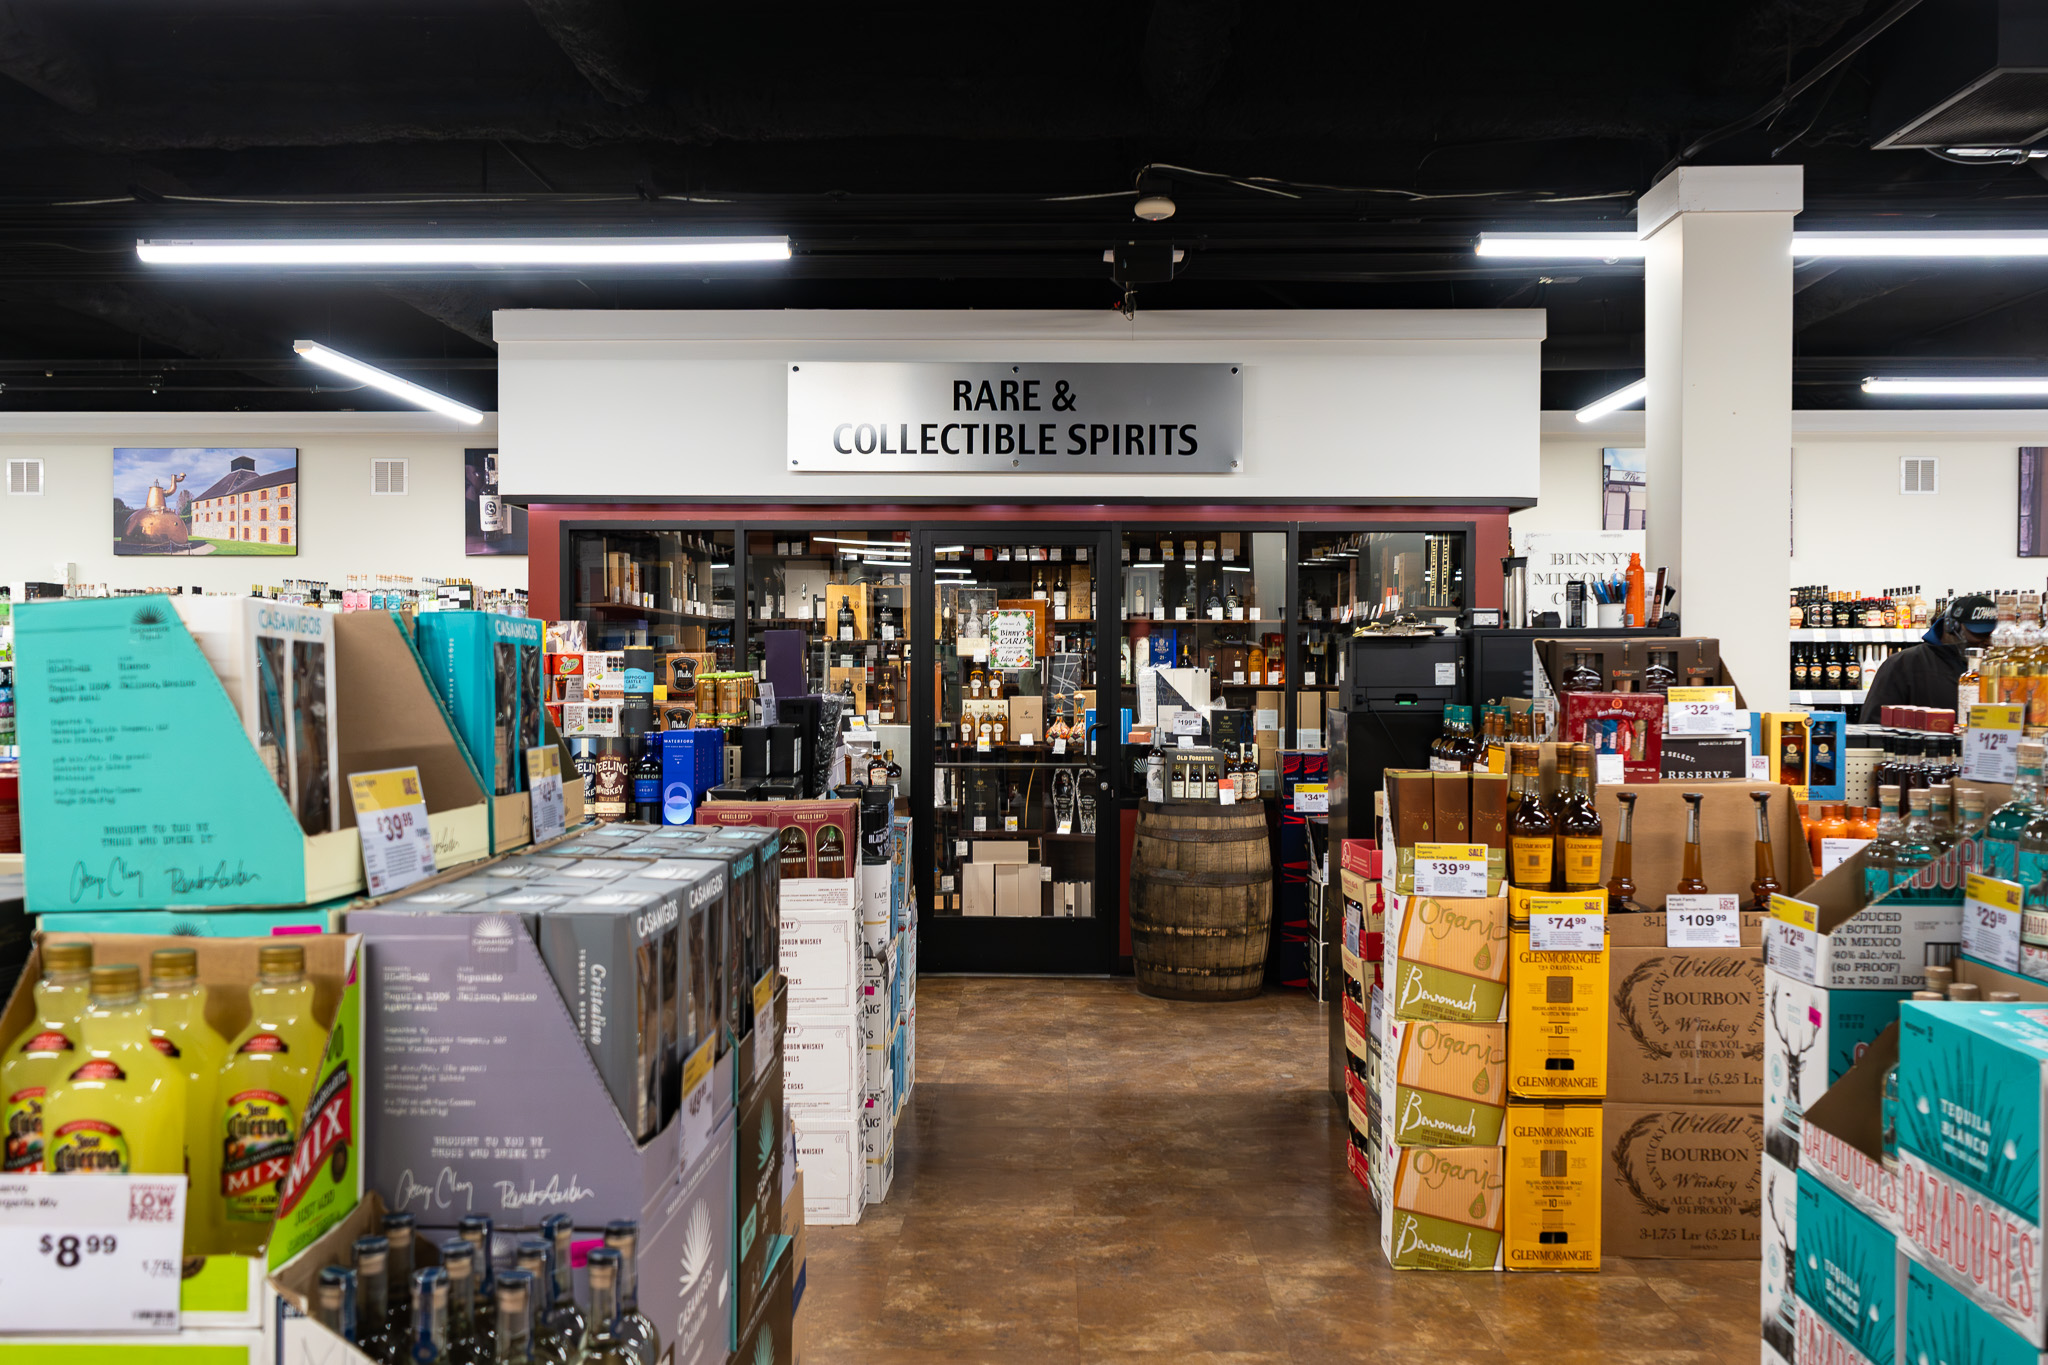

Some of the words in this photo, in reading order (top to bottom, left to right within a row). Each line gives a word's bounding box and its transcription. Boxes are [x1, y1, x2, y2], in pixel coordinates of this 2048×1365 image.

[952, 379, 1042, 412] RARE
[1051, 379, 1077, 412] &
[833, 423, 1057, 455] COLLECTIBLE
[1067, 423, 1199, 457] SPIRITS
[258, 609, 322, 636] CASAMIGOS
[495, 618, 538, 641] CASAMIGOS
[596, 760, 629, 776] TEELING
[1668, 770, 1730, 779] RESERVE
[596, 784, 624, 796] WHISKEY
[1468, 848, 1484, 857] SALE
[689, 873, 723, 909] CASAMIGOS
[637, 898, 678, 937] CASAMIGOS
[1419, 898, 1508, 940] Organic
[1846, 925, 1902, 934] BOTTLED
[1833, 937, 1847, 947] IN
[1851, 937, 1901, 947] MEXICO
[1519, 951, 1601, 964] GLENMORANGIE
[1832, 950, 1856, 959] 40%
[1669, 955, 1746, 978] Willett
[1854, 962, 1900, 974] PROOF)
[1400, 965, 1477, 1013] Benromach
[1832, 976, 1844, 984] 12
[1859, 976, 1880, 985] 750
[1882, 976, 1898, 984] ml
[590, 962, 607, 1046] Cristalino
[1648, 969, 1670, 1035] KENTUCKY
[1663, 992, 1751, 1006] BOURBON
[1554, 1025, 1563, 1034] 10
[1675, 1016, 1740, 1039] Whiskey
[1417, 1024, 1507, 1065] Organic
[1696, 1050, 1736, 1059] PROOF)
[1516, 1075, 1598, 1088] GLENMORANGIE
[1641, 1072, 1679, 1085] 3-1.75
[1684, 1072, 1704, 1085] Ltr
[1707, 1072, 1740, 1086] (5.25
[1400, 1091, 1476, 1138] Benromach
[1666, 1111, 1744, 1134] Willett
[1940, 1098, 1992, 1136] TEQUILA
[1513, 1126, 1595, 1138] GLENMORANGIE
[1940, 1120, 1989, 1156] BLANCO
[286, 1098, 344, 1197] MIX
[1646, 1125, 1668, 1191] KENTUCKY
[1661, 1148, 1749, 1162] BOURBON
[227, 1158, 287, 1192] MIX
[1413, 1149, 1503, 1190] Organic
[1672, 1172, 1738, 1195] Whiskey
[130, 1193, 175, 1208] LOW
[1548, 1198, 1557, 1208] 10
[1693, 1206, 1732, 1215] PROOF)
[128, 1208, 175, 1222] PRICE
[1396, 1215, 1472, 1262] Benromach
[1639, 1228, 1676, 1240] 3-1.75
[1681, 1228, 1701, 1240] Ltr
[1705, 1228, 1737, 1241] (5.25
[1903, 1162, 2034, 1318] CAZADORES
[1511, 1249, 1593, 1261] GLENMORANGIE
[1824, 1257, 1861, 1296] TEQUILA
[677, 1260, 714, 1336] CASAMIGOS
[1824, 1280, 1860, 1315] BLANCO
